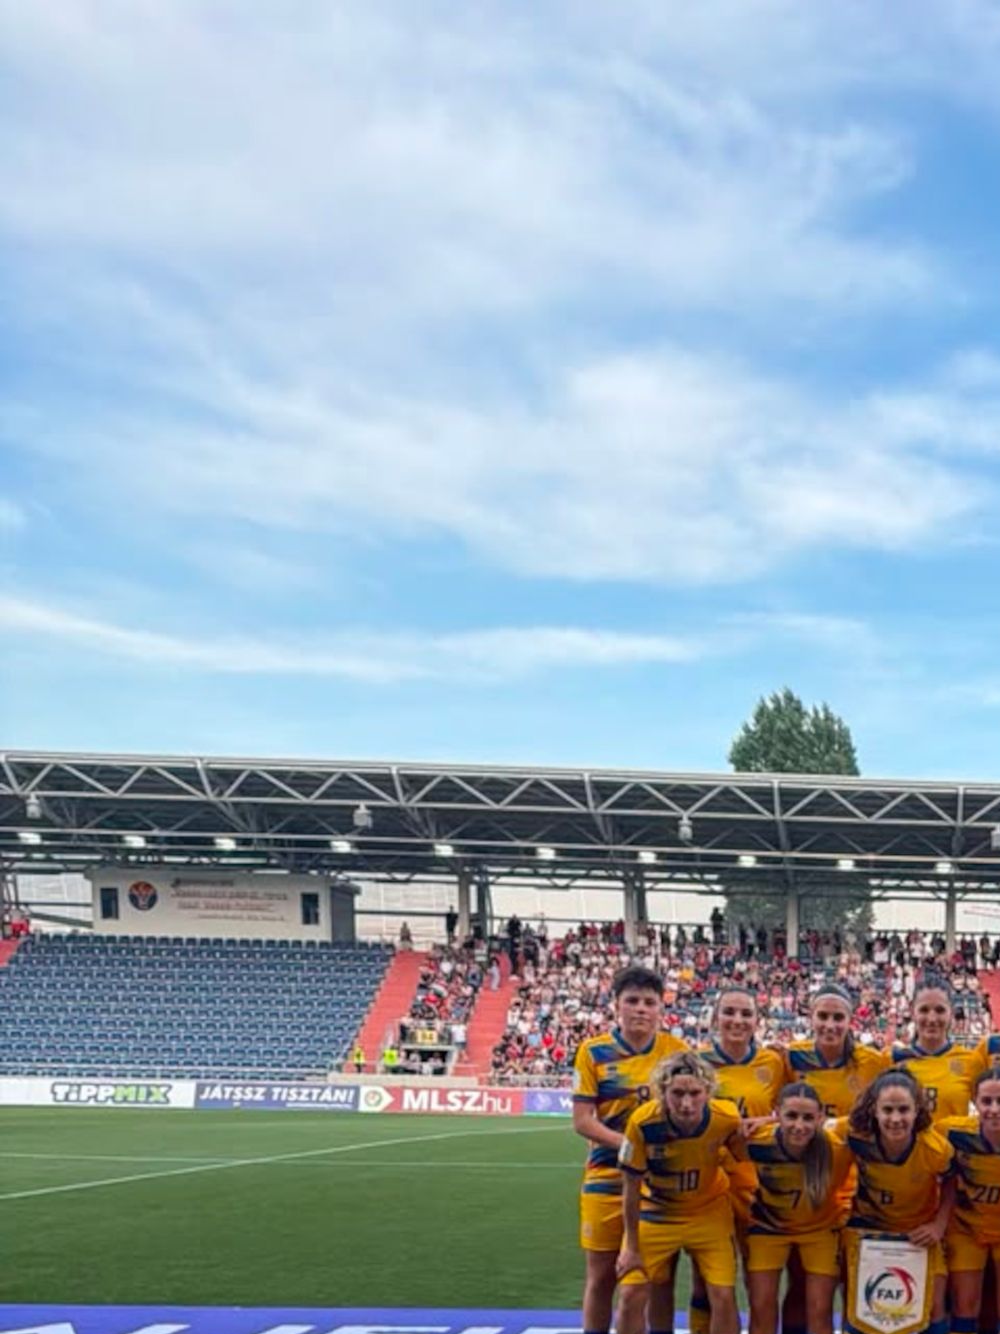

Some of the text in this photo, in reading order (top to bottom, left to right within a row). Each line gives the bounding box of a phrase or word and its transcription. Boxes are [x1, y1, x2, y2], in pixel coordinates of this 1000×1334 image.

[200, 1083, 356, 1103] JÁTSSZ TISZTÁN!
[402, 1089, 512, 1113] MLSZ.hu
[678, 1169, 699, 1192] 10
[973, 1185, 1000, 1204] 20
[877, 1289, 905, 1300] FAF
